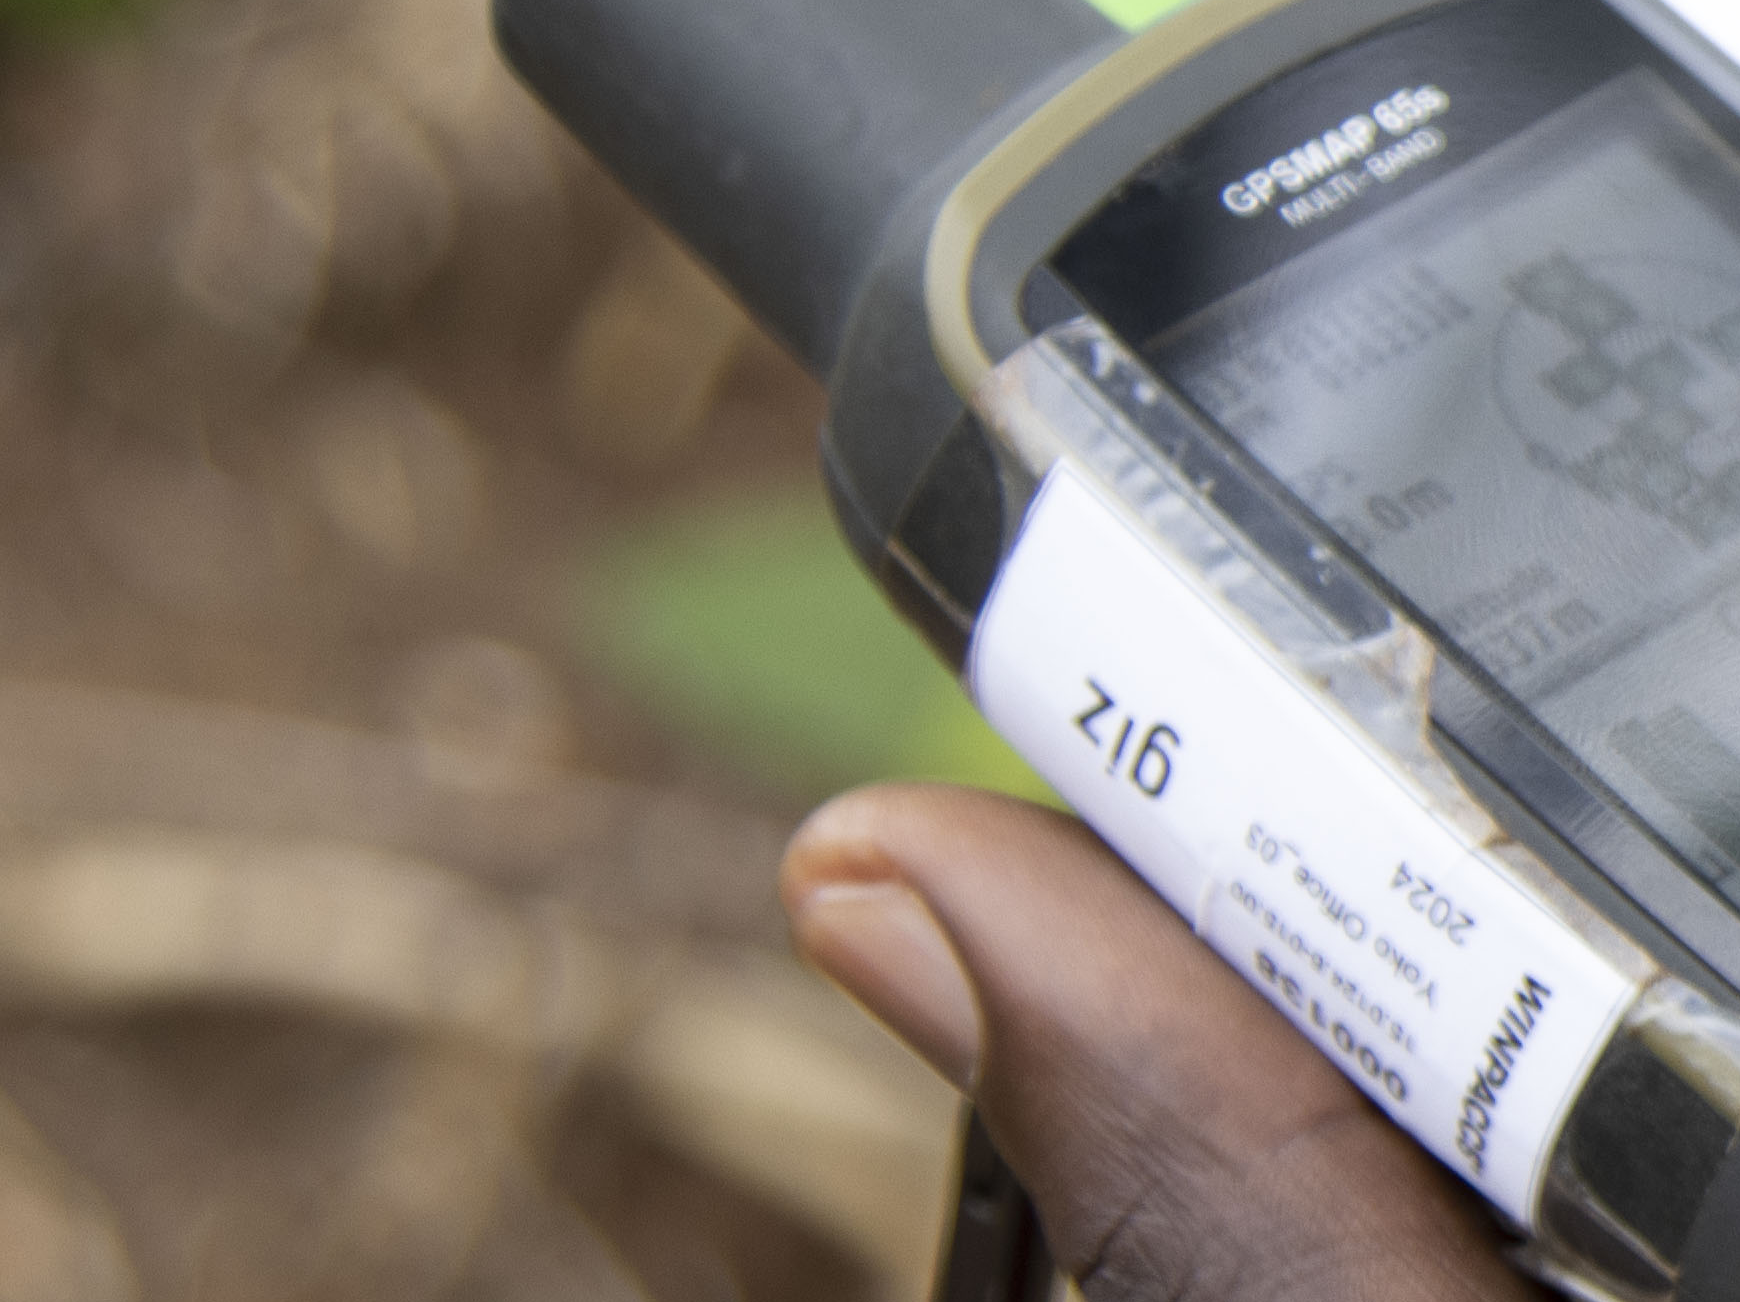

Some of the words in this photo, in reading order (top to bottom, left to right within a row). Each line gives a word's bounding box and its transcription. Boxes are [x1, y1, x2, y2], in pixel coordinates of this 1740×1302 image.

[1221, 113, 1378, 216] GPSMAP
[1371, 84, 1450, 136] 65s
[1070, 677, 1184, 802] giz
[1391, 860, 1476, 947] 2024
